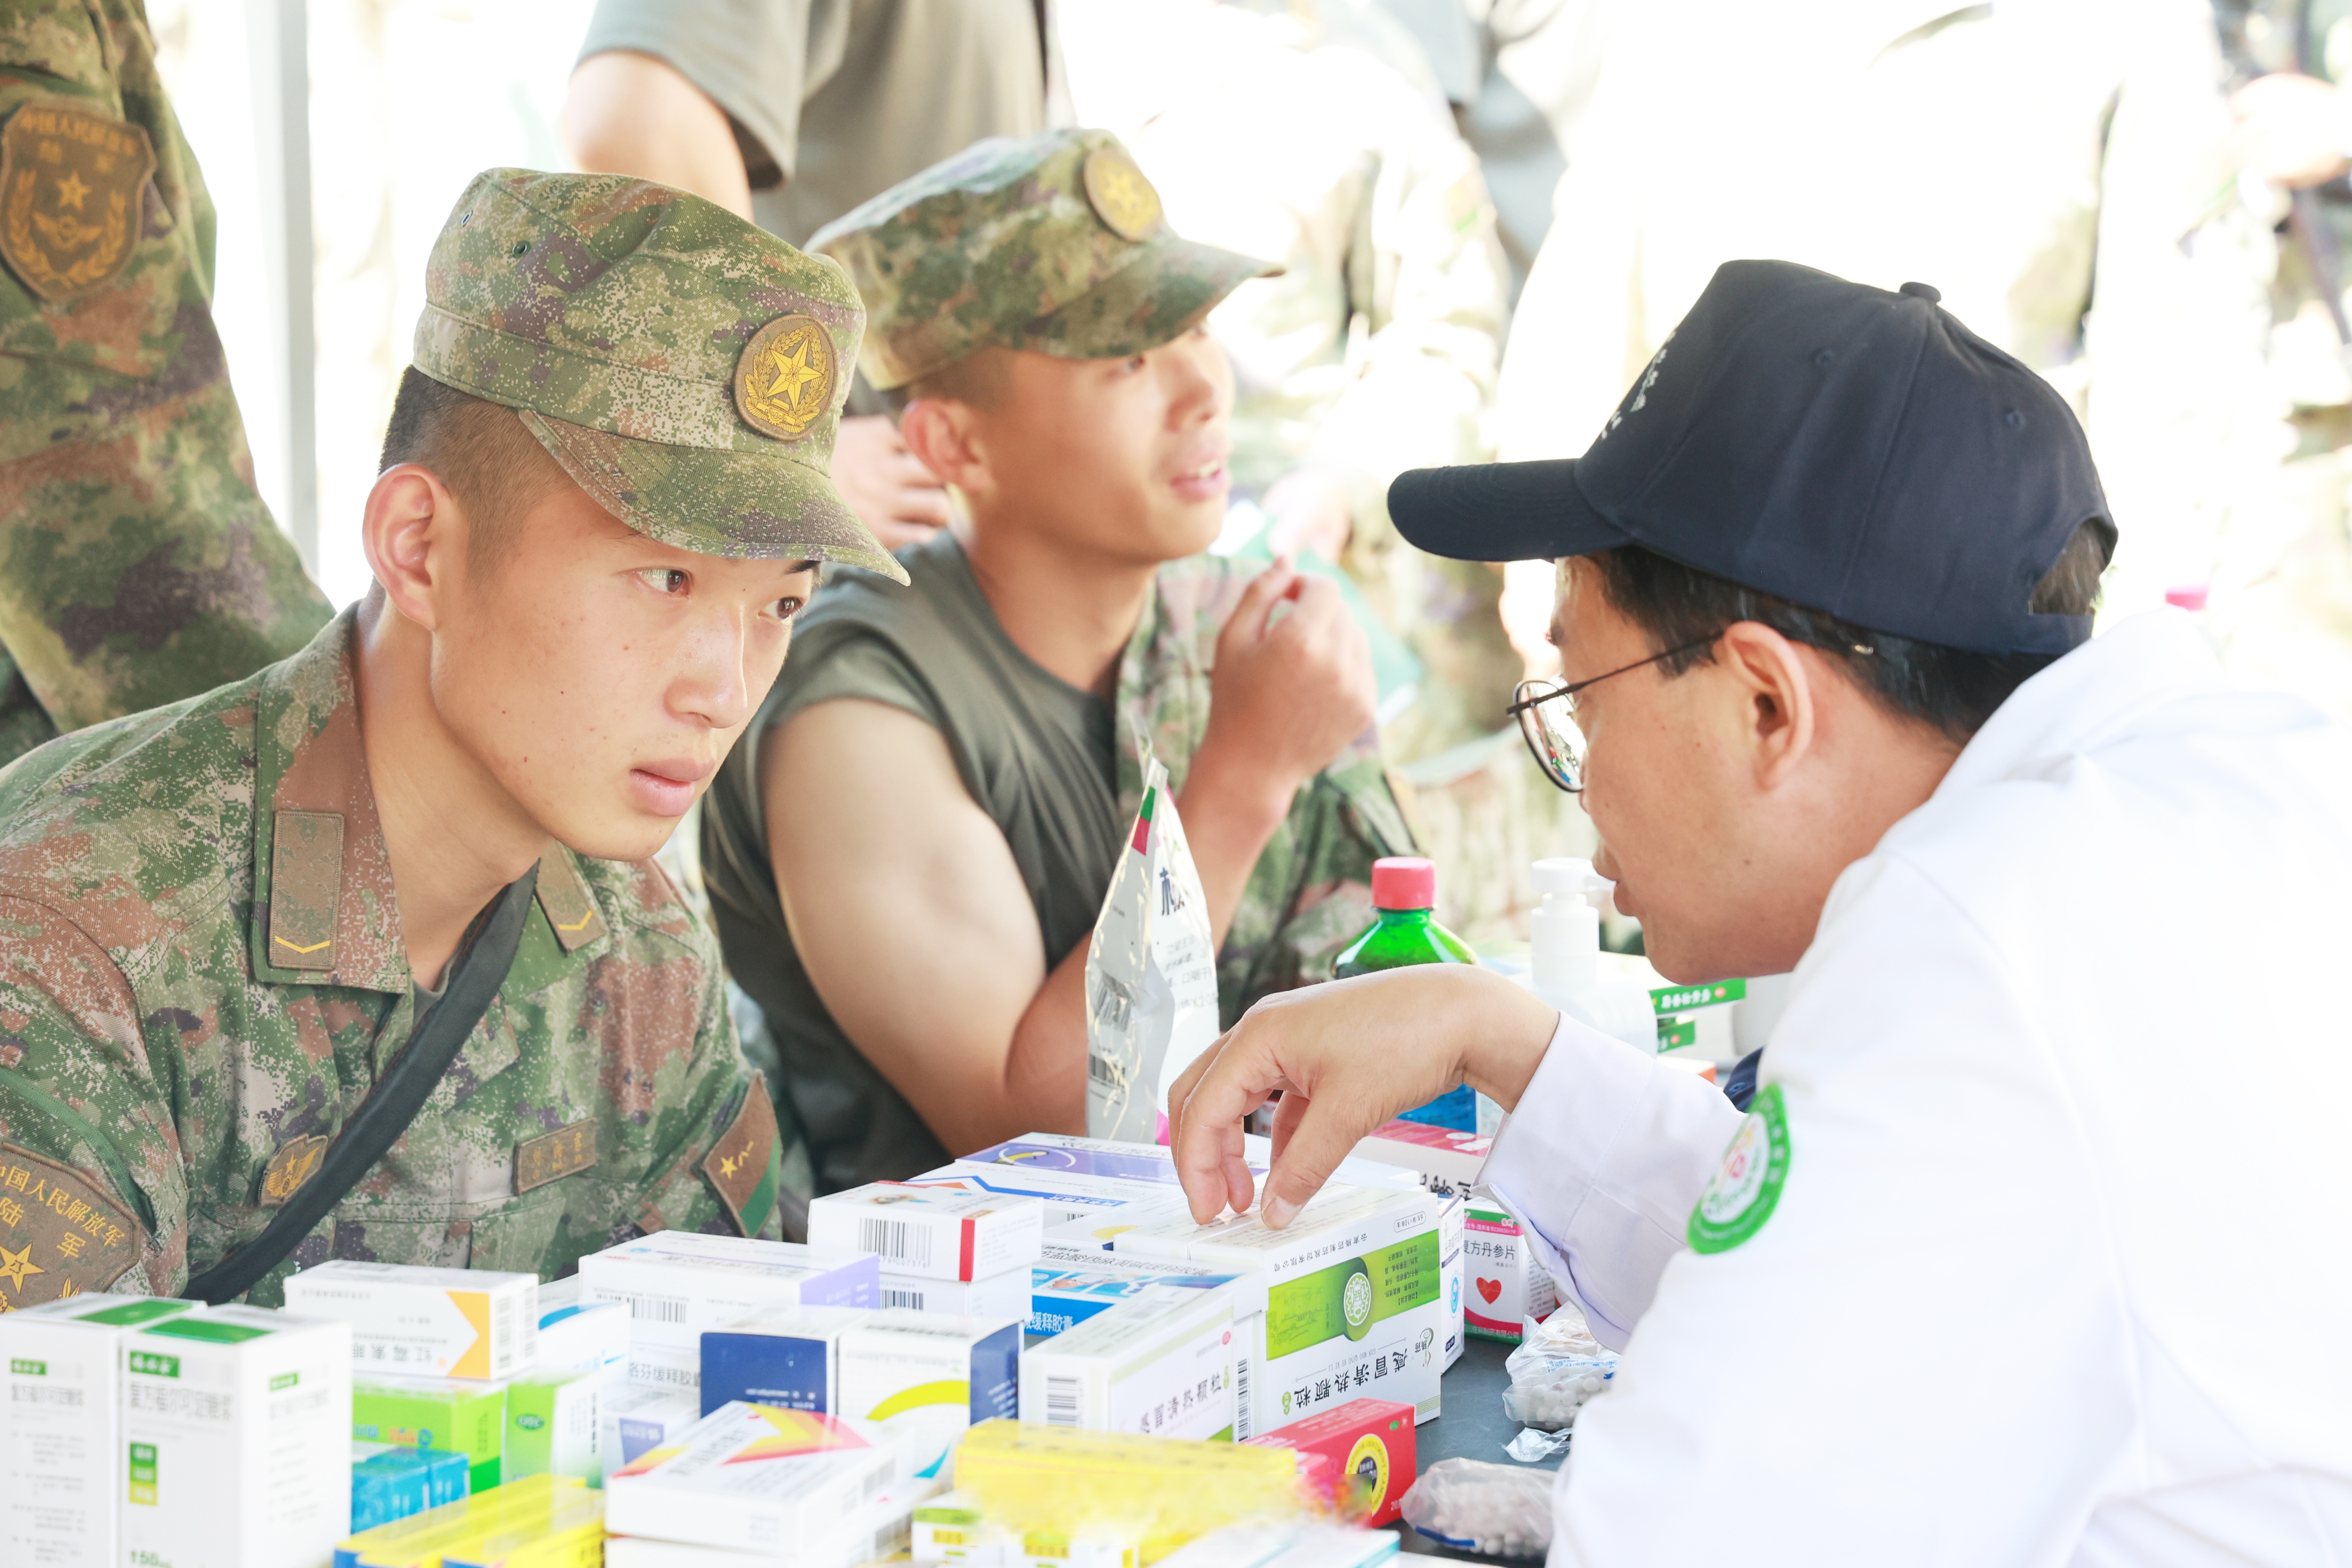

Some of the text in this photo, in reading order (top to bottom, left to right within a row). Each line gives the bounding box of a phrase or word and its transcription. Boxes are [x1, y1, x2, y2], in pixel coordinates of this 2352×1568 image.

[0, 1196, 87, 1259] 陆 军
[1274, 1232, 1368, 1272] 云南腾药制药股份有限公司
[1139, 1374, 1222, 1432] 感冒清热颗粒
[1294, 1348, 1408, 1409] 感冒清热颗粒
